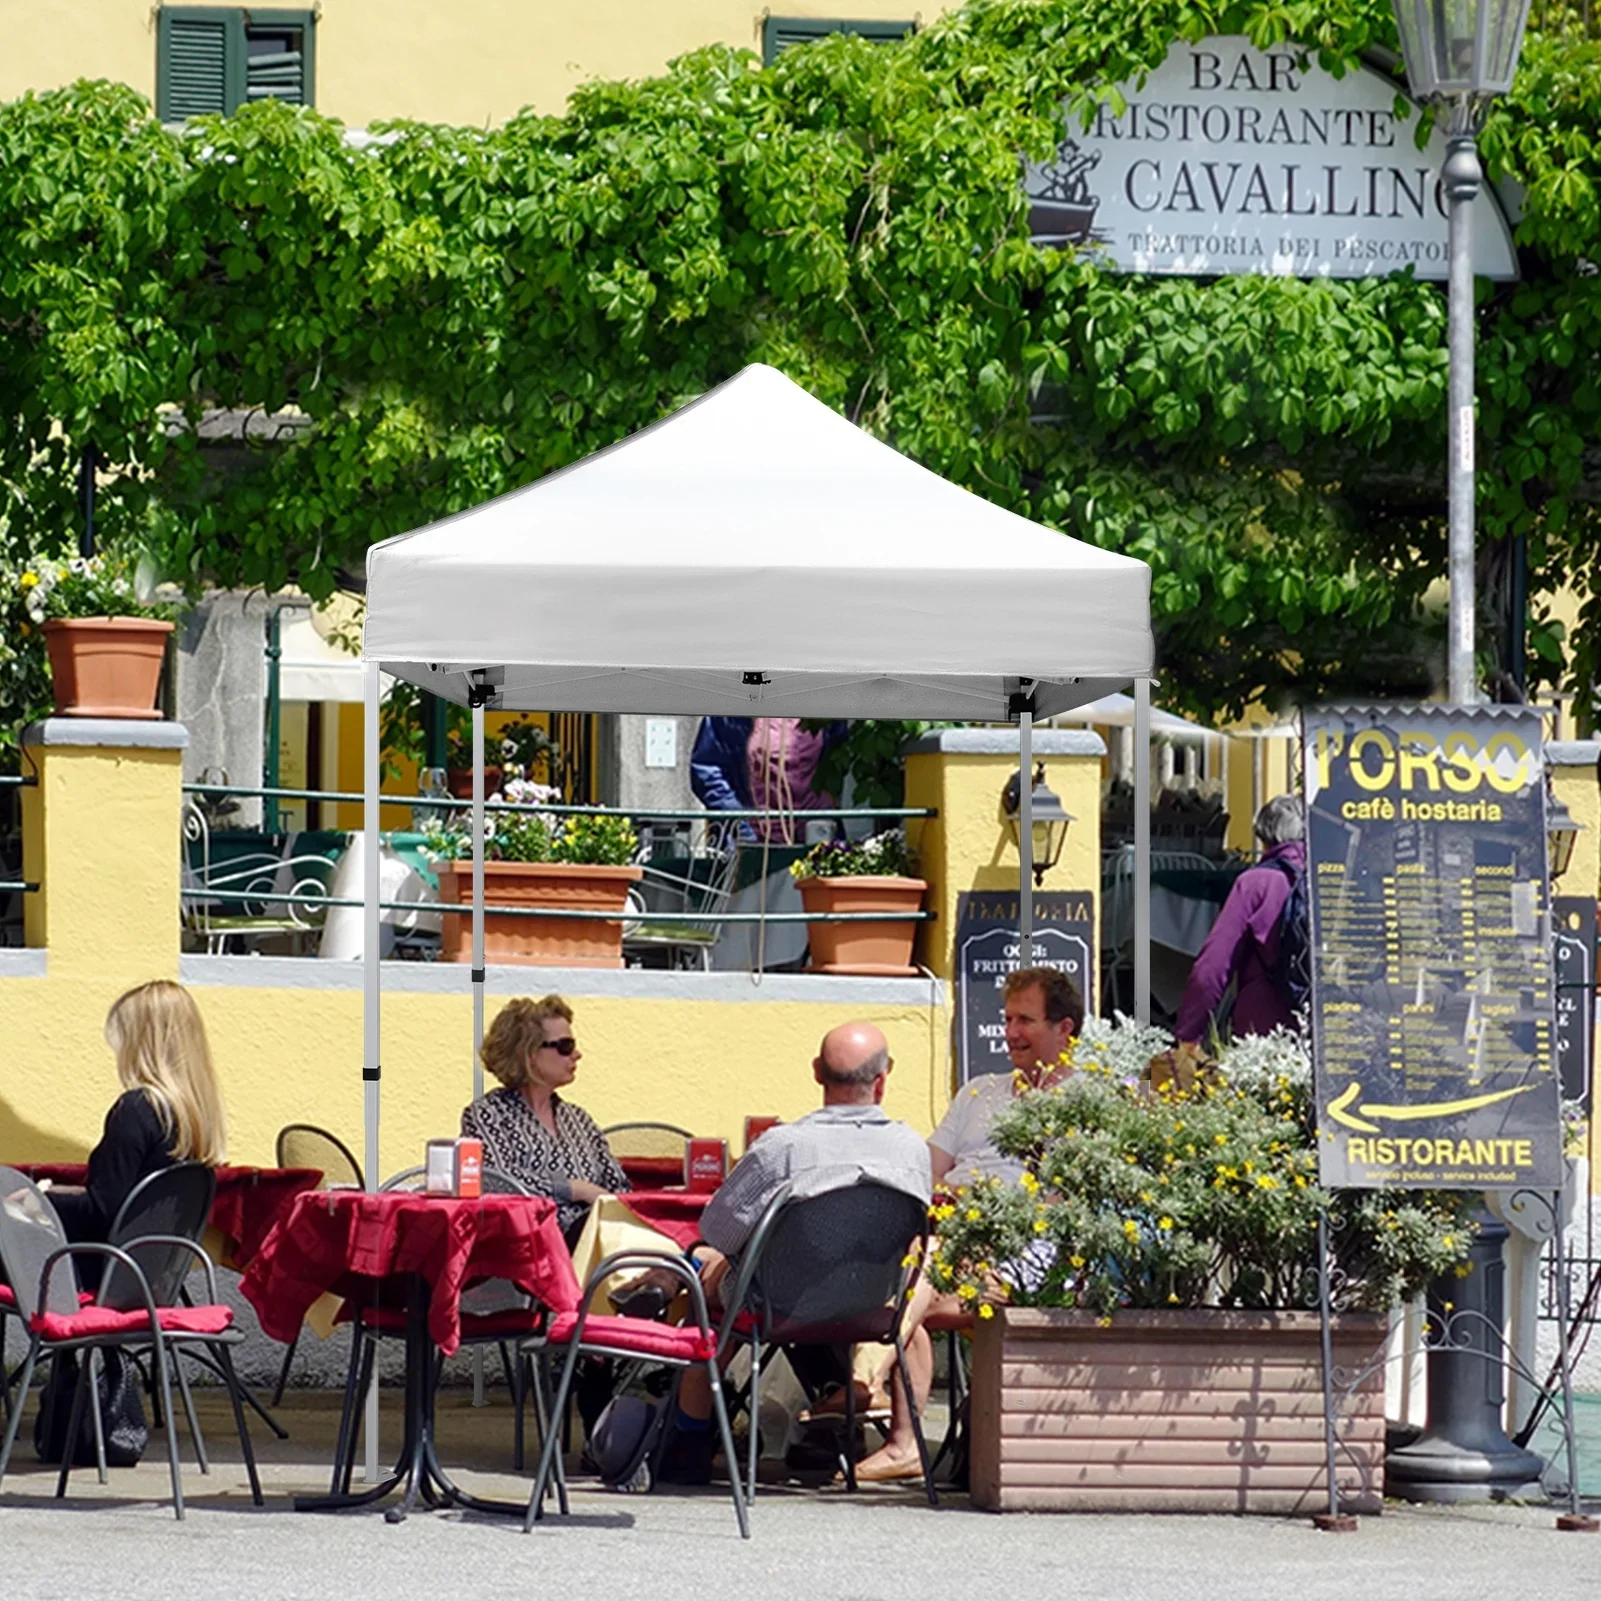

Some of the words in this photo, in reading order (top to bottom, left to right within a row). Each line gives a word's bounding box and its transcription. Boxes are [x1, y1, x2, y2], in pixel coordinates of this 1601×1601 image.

[1189, 51, 1300, 92] BAR
[1093, 102, 1396, 148] RISTORANTE
[1128, 232, 1264, 257] TRATTORIA
[1278, 238, 1320, 258] DEI
[1401, 798, 1504, 822] hostaria
[1317, 862, 1346, 874] pizza
[1347, 1137, 1533, 1166] RISTORANTE
